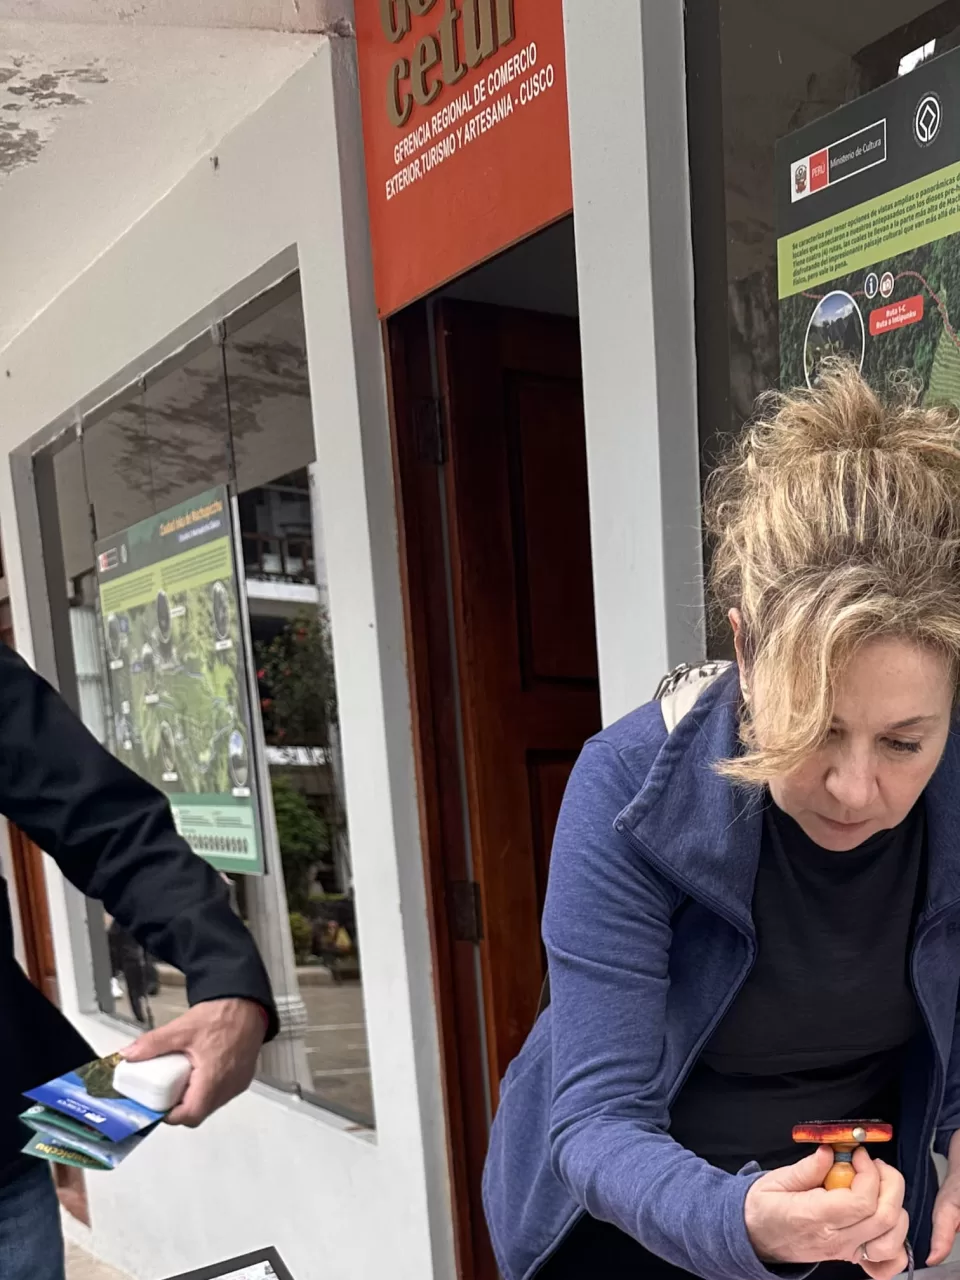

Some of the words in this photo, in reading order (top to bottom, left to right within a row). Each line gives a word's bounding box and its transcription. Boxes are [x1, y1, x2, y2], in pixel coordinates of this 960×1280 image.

[421, 133, 456, 174] TURISMO
[456, 127, 463, 149] Y
[464, 93, 513, 144] ARTESANIA
[519, 64, 555, 106] CUSCO
[431, 91, 473, 137] REGIONAL
[474, 79, 486, 106] DE
[487, 42, 537, 95] COMERCIO
[863, 138, 881, 154] Cultura
